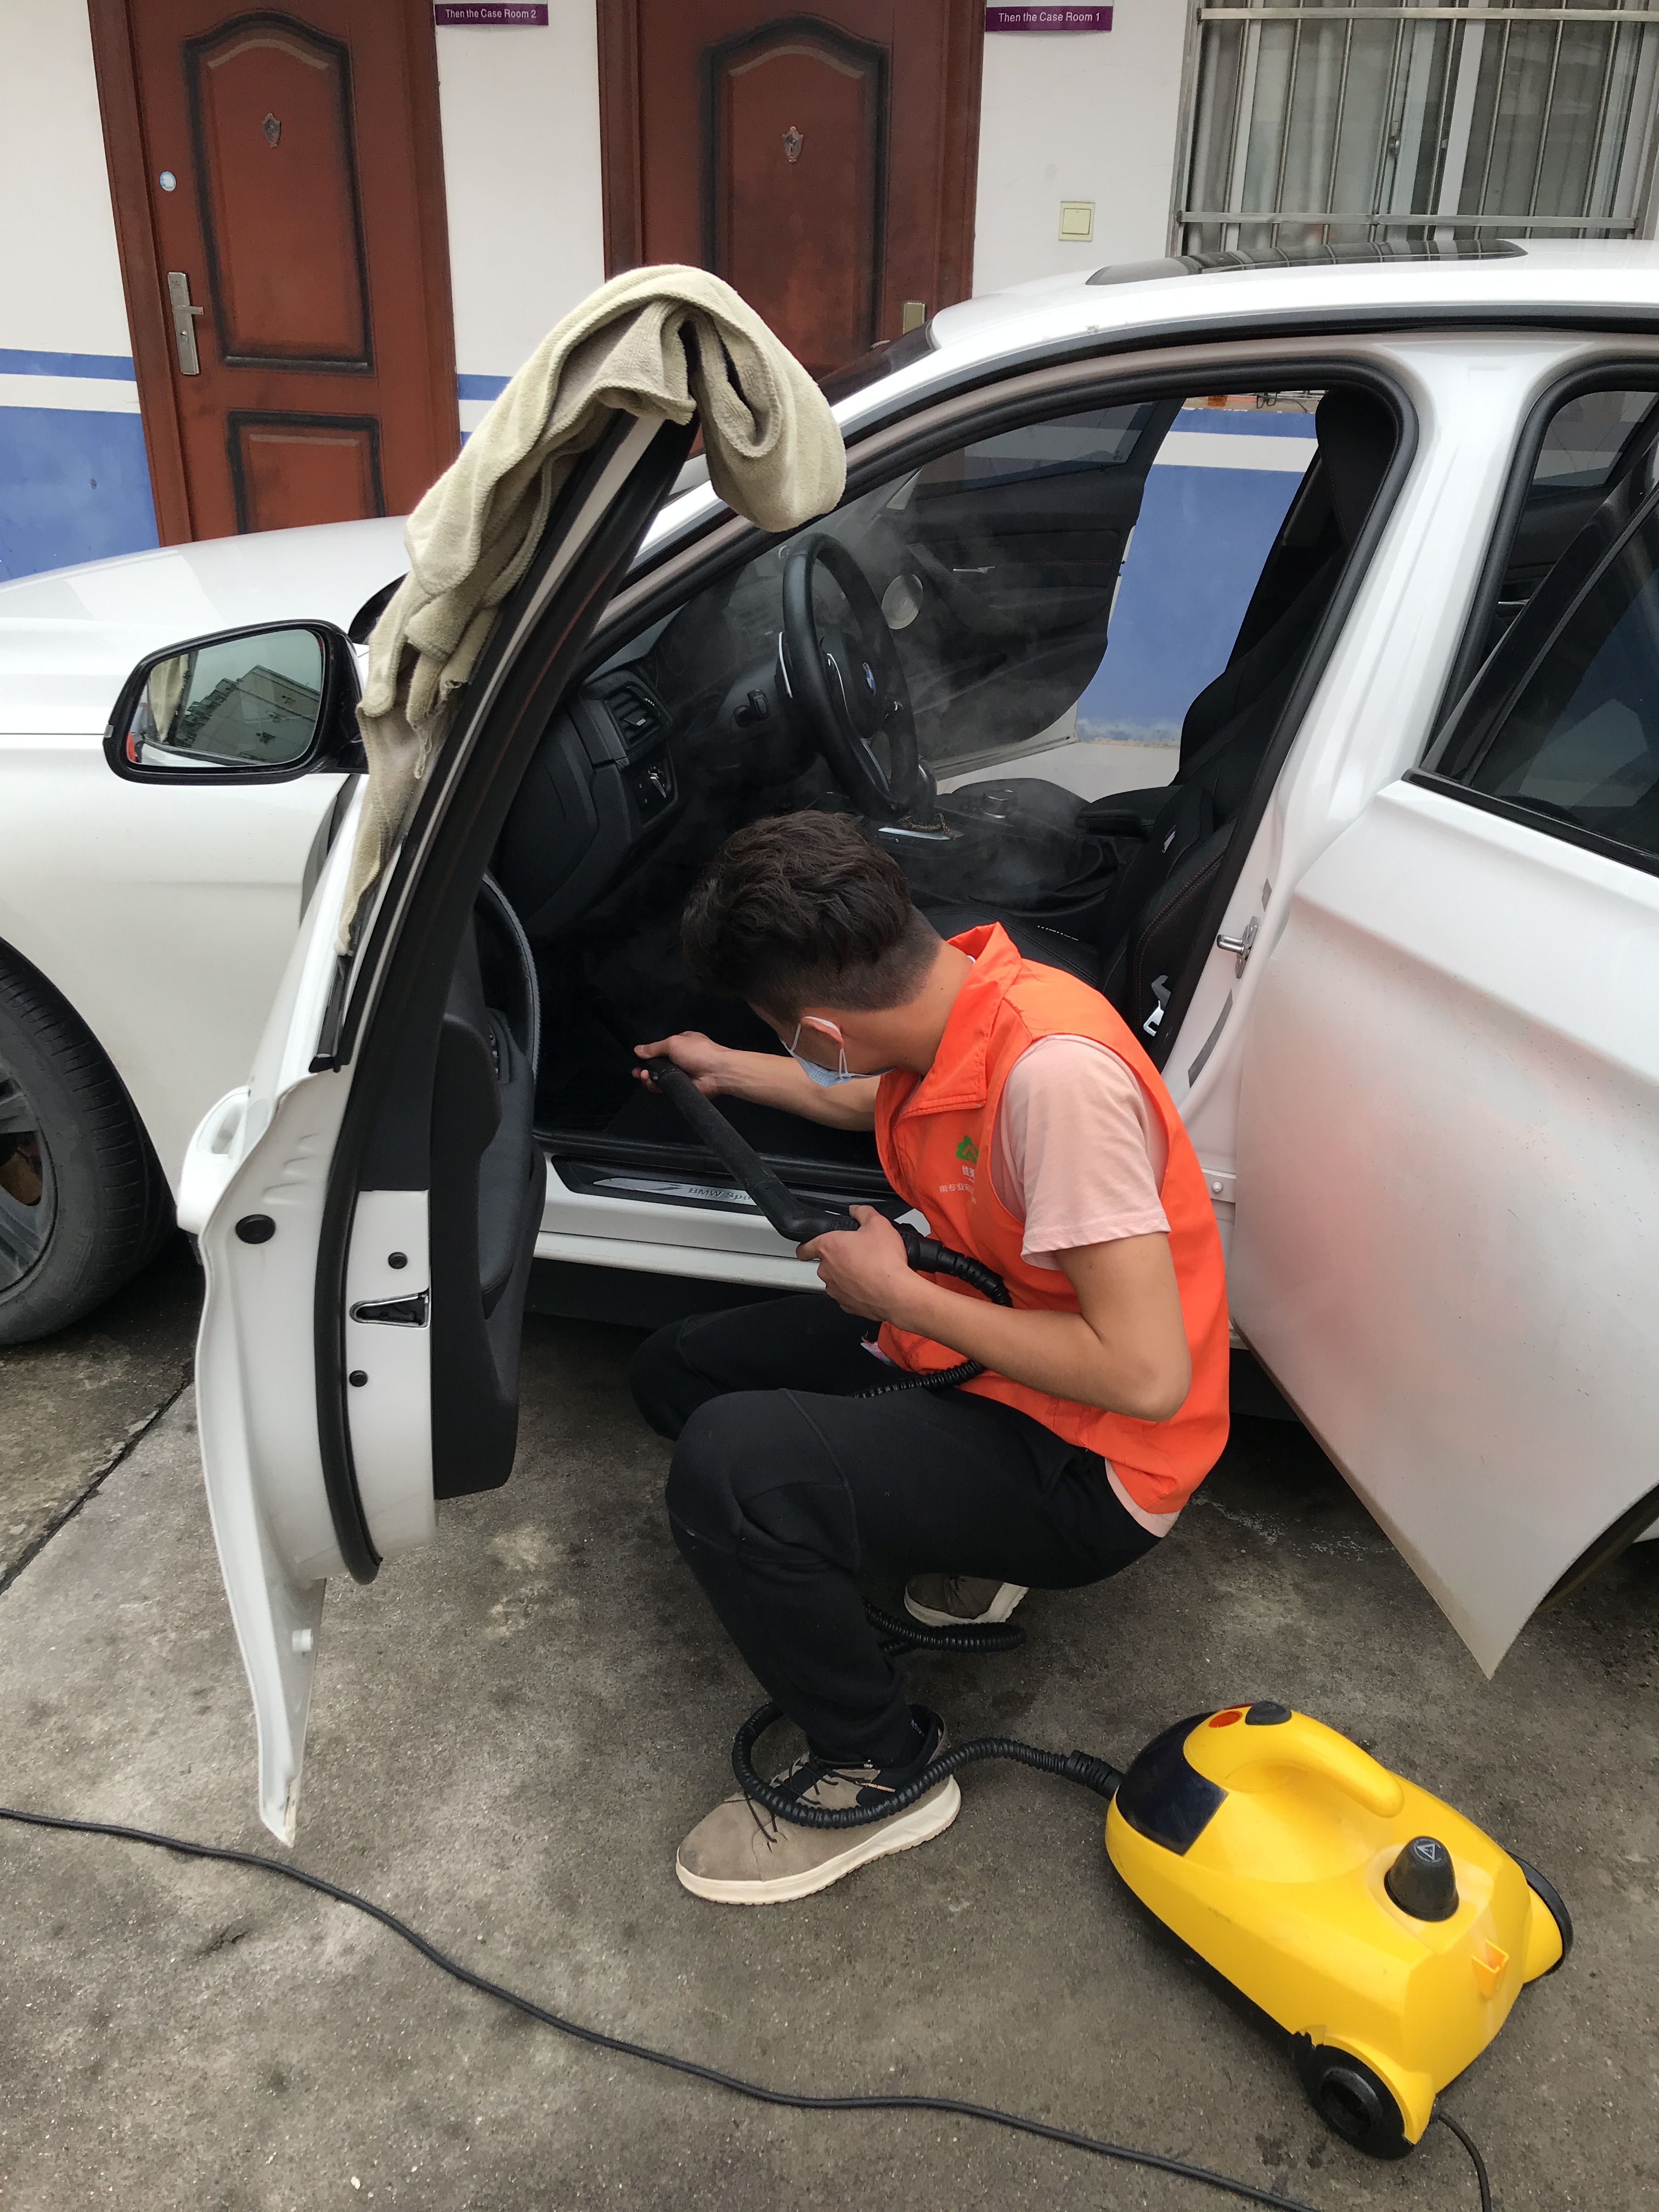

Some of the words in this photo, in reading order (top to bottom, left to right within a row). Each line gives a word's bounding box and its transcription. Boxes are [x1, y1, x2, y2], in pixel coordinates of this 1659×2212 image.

[445, 9, 465, 18] Then
[466, 9, 479, 18] the
[481, 9, 502, 18] Case
[504, 9, 529, 18] Room
[531, 9, 537, 19] 2
[998, 13, 1021, 22] Then
[1023, 13, 1037, 22] the
[1039, 12, 1063, 22] Case
[1065, 12, 1093, 22] Room
[1096, 12, 1100, 21] 1
[688, 1188, 724, 1198] BMW
[725, 1192, 753, 1201] Spo
